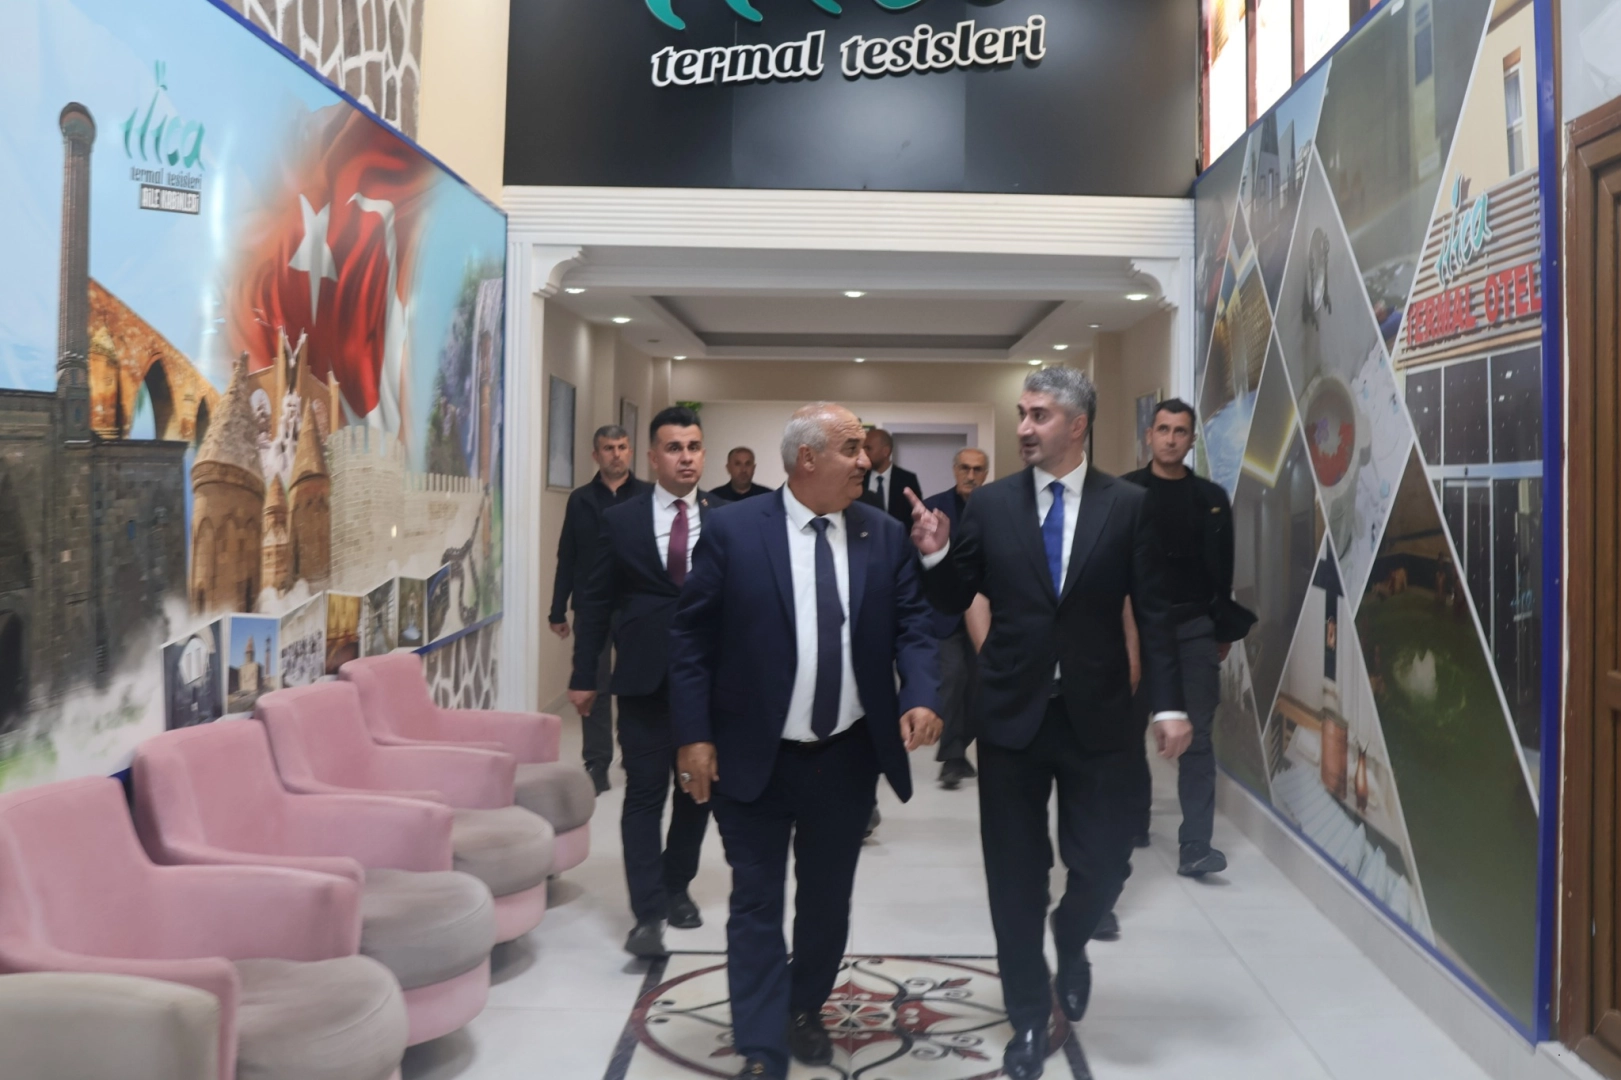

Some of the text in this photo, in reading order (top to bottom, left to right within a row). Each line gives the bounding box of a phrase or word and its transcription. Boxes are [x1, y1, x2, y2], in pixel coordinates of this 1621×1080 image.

[651, 29, 826, 87] termal
[840, 15, 1046, 77] tesisleri
[130, 166, 203, 190] termal tesisleri
[1406, 262, 1542, 345] TERMAL OTEL
